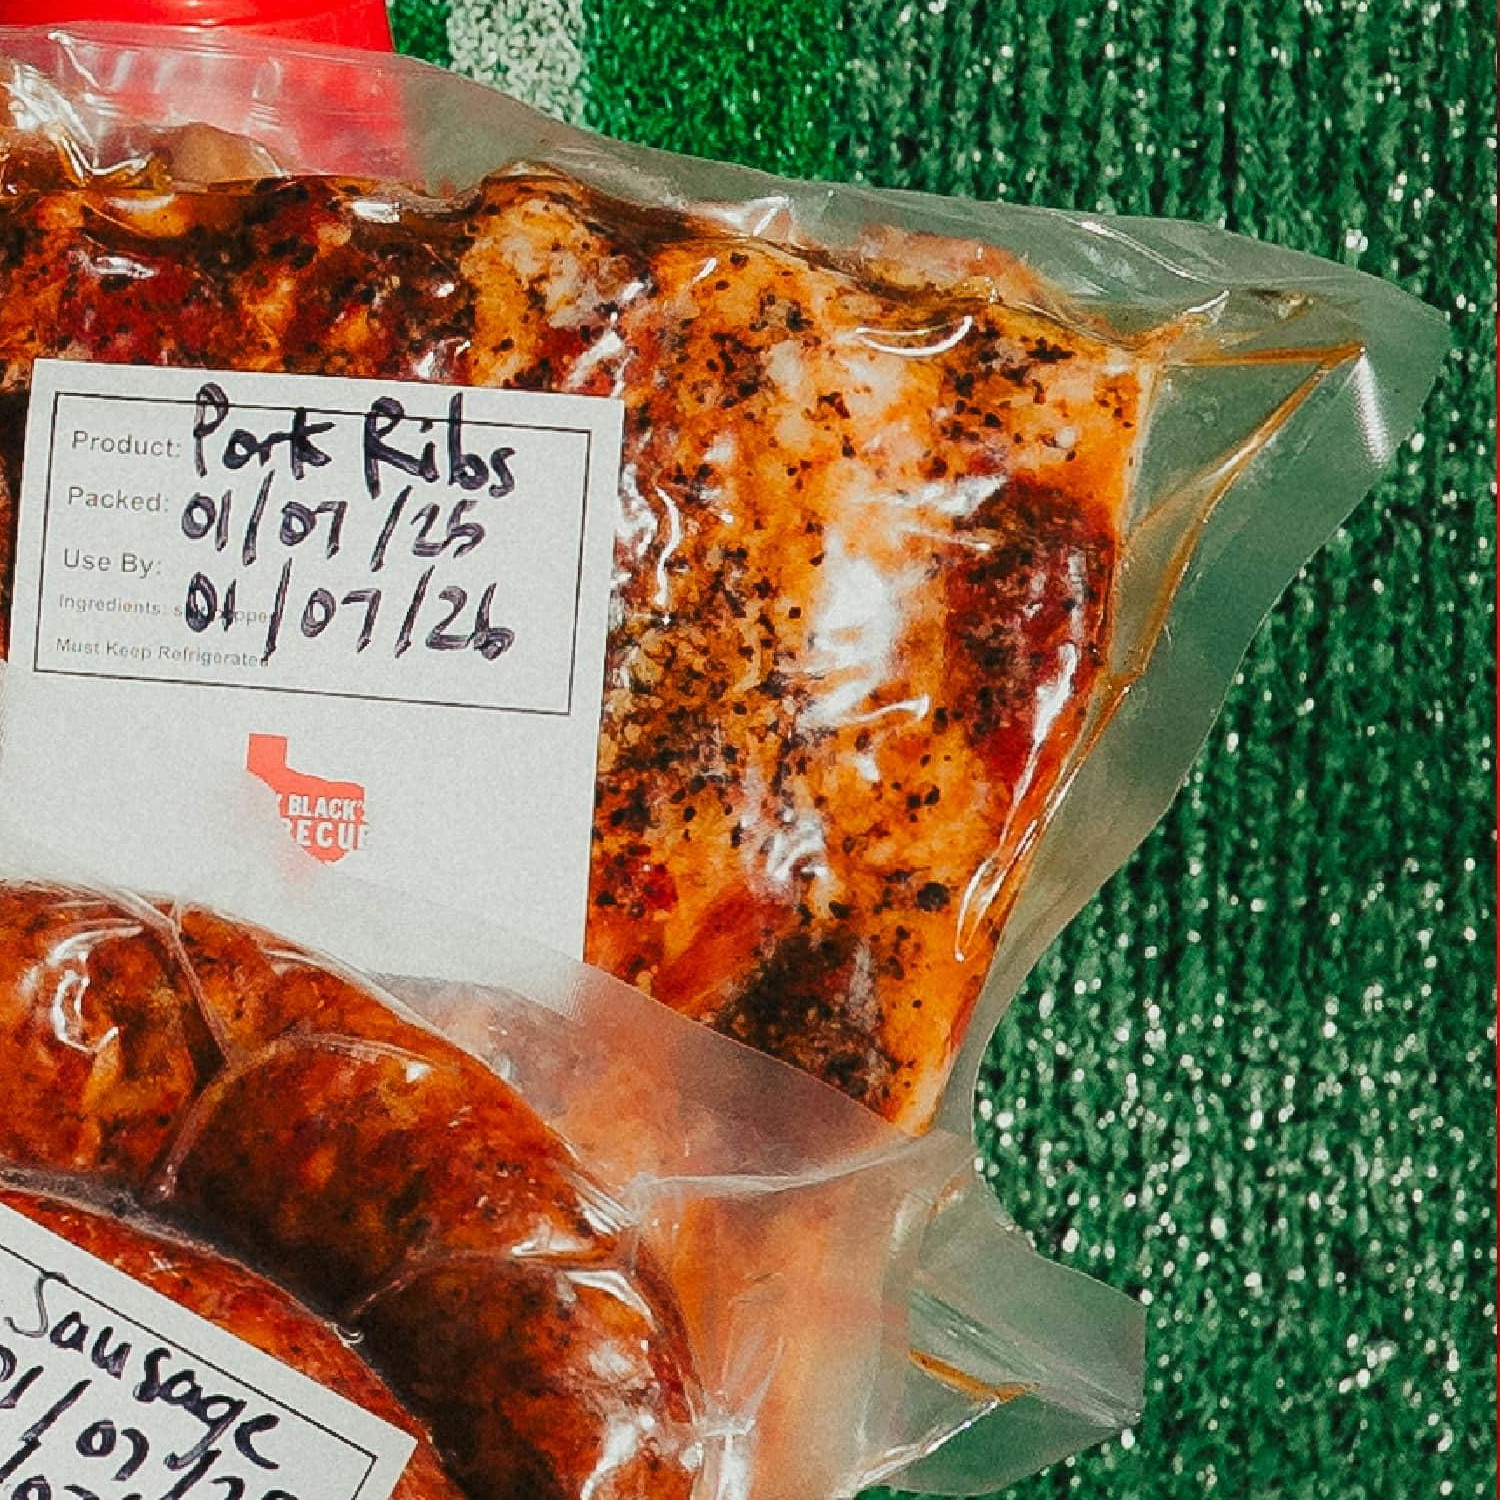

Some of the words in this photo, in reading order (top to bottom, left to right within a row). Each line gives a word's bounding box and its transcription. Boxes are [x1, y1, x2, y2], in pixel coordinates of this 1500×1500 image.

[71, 429, 182, 458] Product:
[192, 381, 336, 480] Pork
[363, 391, 516, 499] Ribs
[67, 486, 169, 514] Packed:
[63, 547, 112, 572] Use
[120, 553, 162, 579] By:
[55, 637, 100, 654] Must
[105, 640, 152, 661] Keep
[3, 1271, 281, 1470] Sausage
